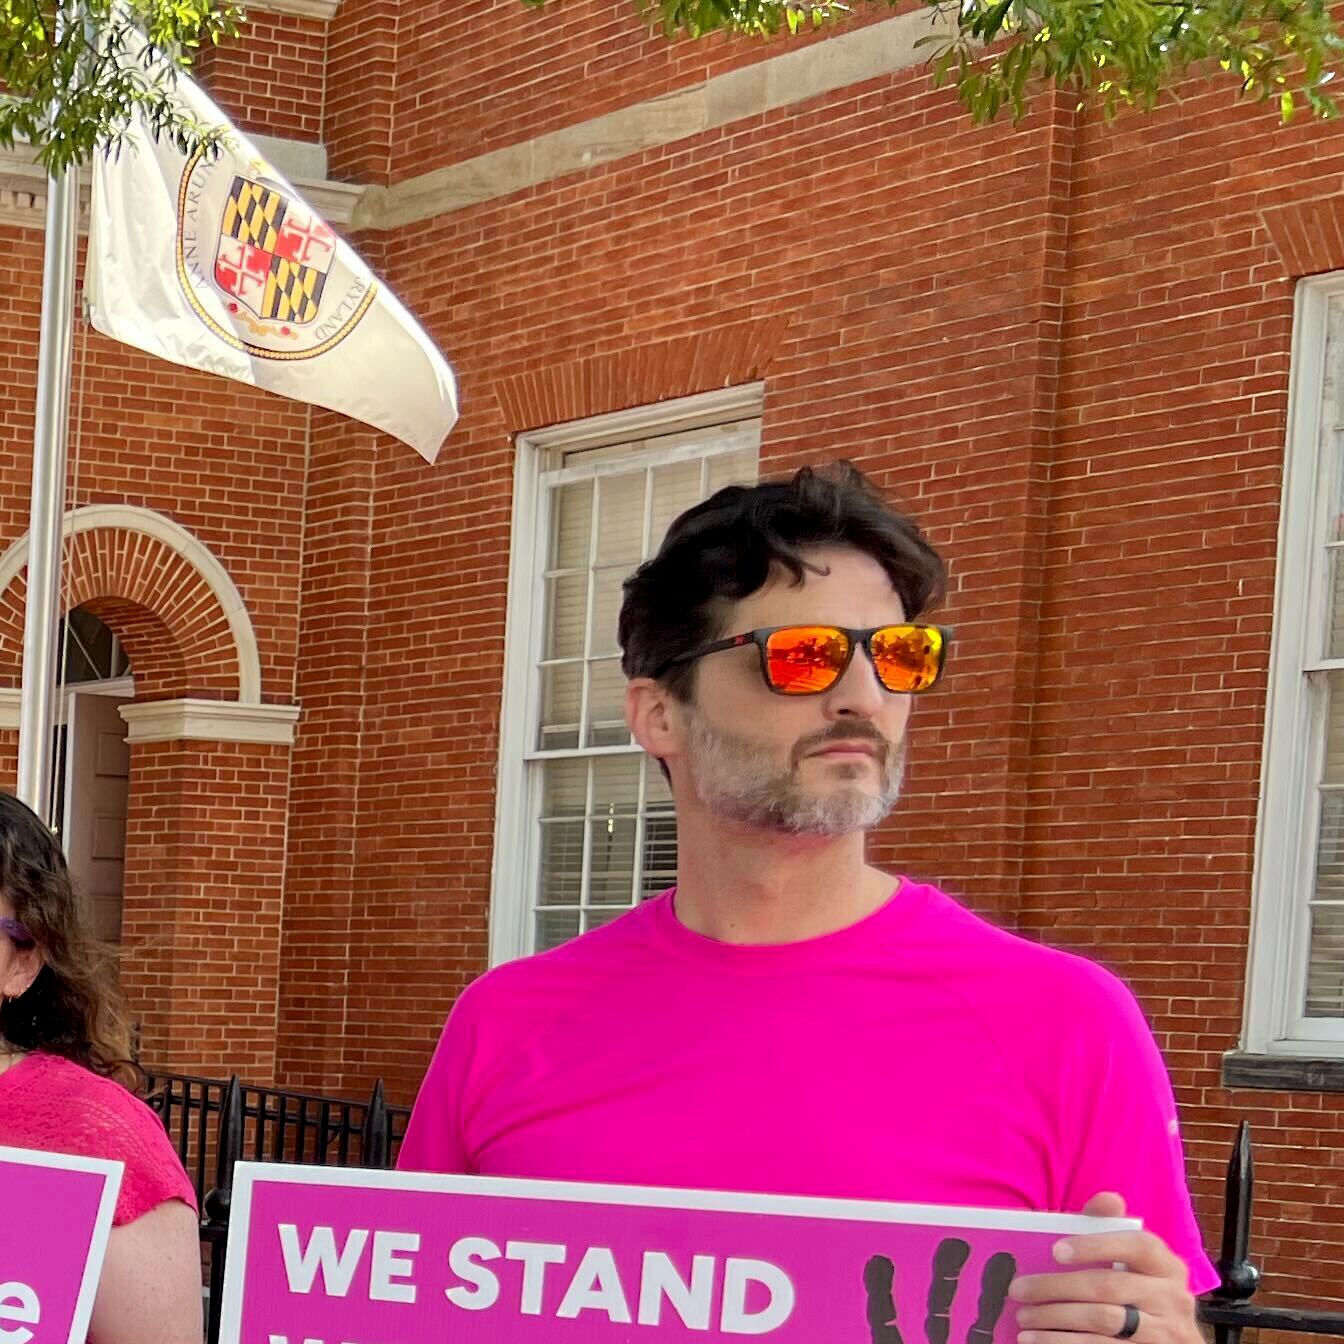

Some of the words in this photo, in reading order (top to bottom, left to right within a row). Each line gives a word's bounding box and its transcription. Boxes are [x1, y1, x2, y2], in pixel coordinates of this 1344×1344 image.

[184, 230, 209, 288] ANNE
[277, 1222, 422, 1304] WE
[444, 1235, 797, 1336] STAND
